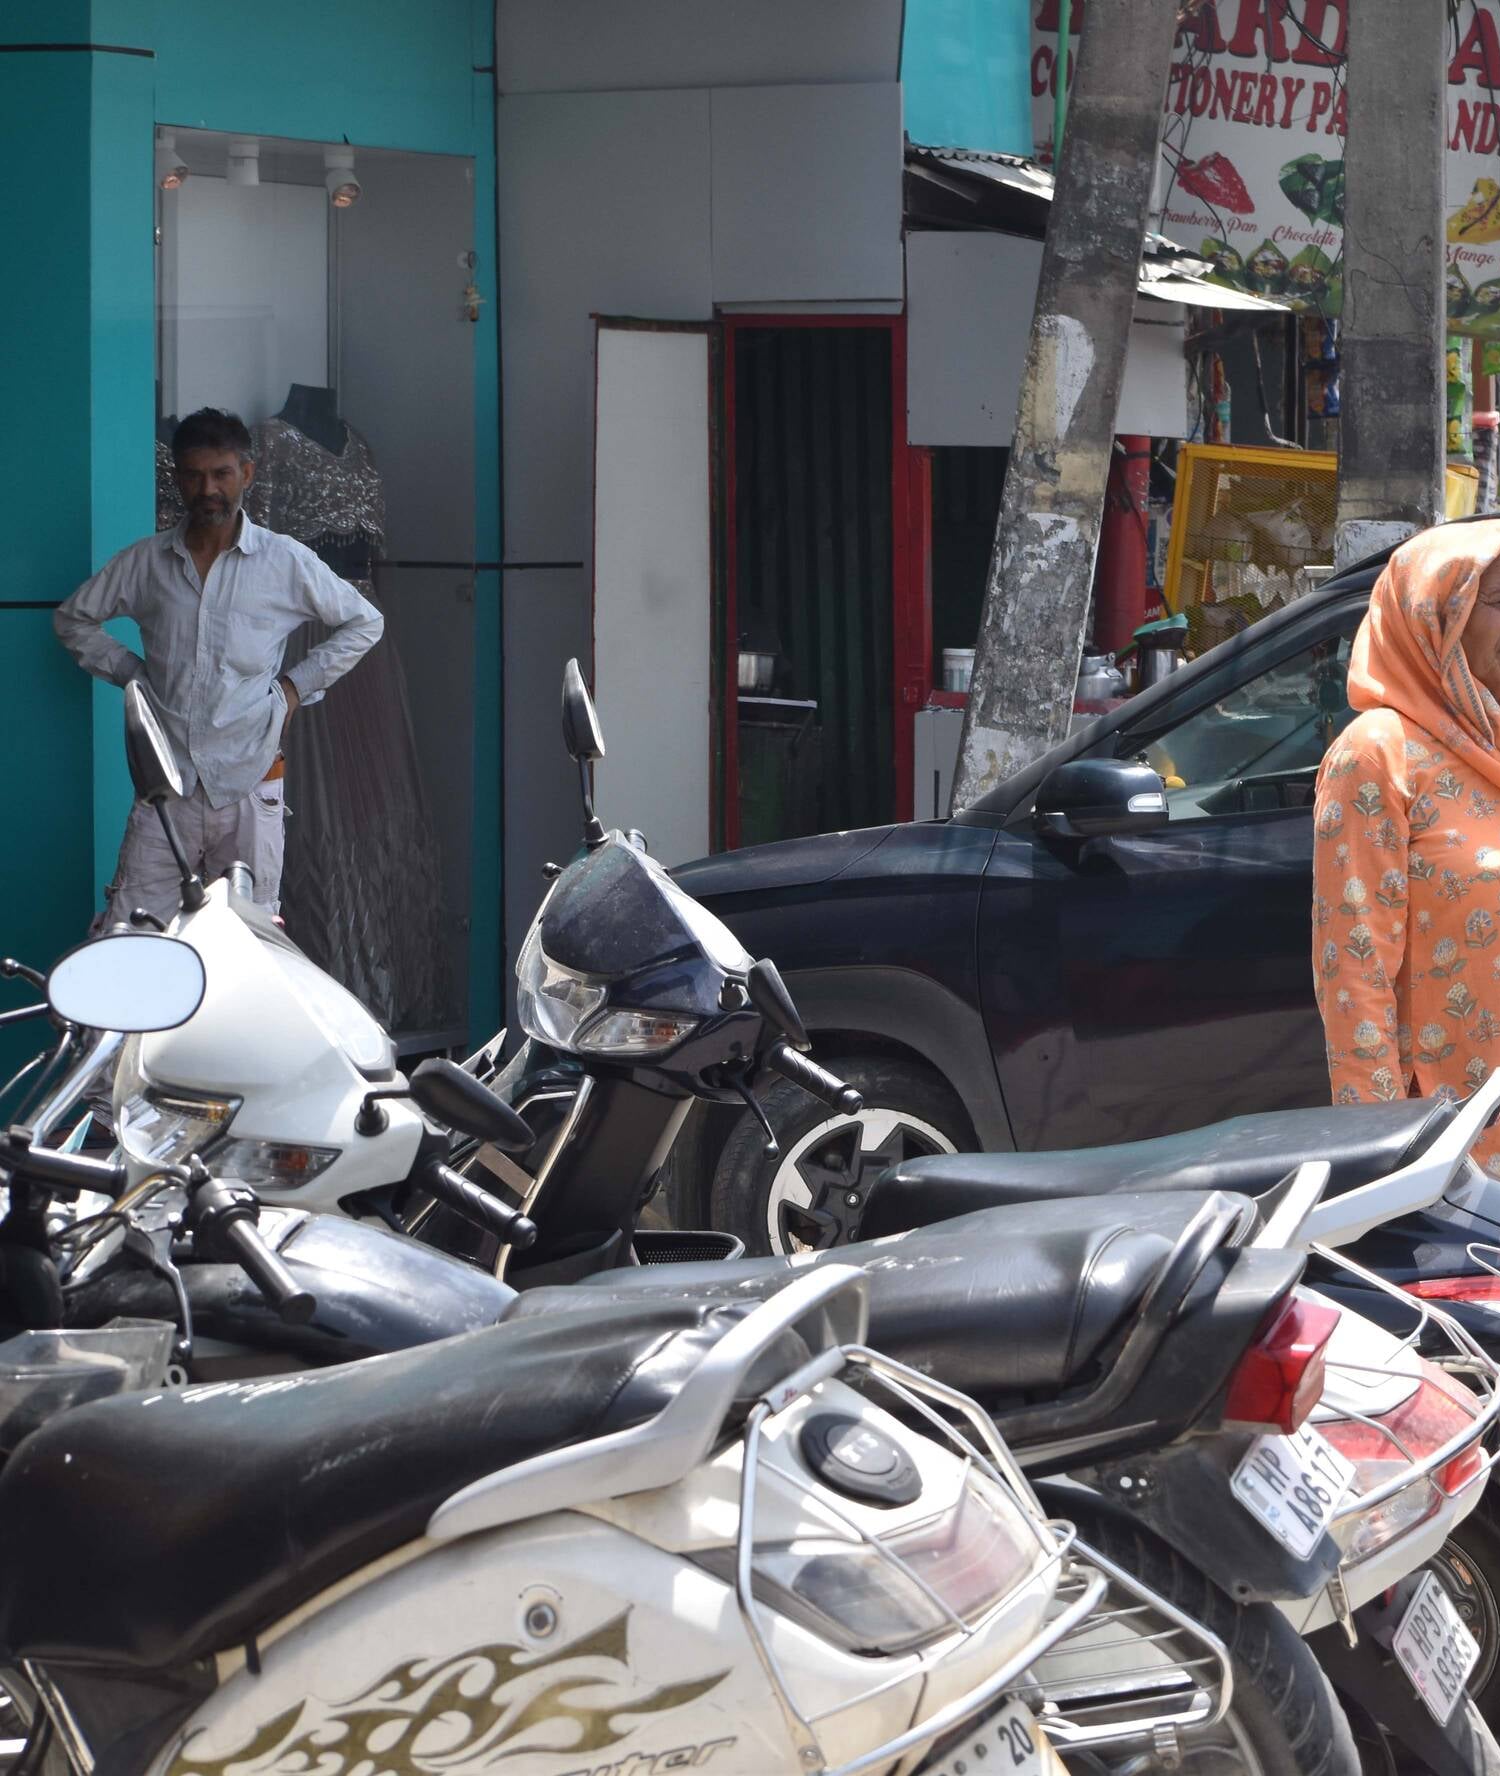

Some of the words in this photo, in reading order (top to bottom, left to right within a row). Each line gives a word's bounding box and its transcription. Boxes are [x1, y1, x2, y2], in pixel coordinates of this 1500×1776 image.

[1306, 81, 1347, 136] PA
[1161, 207, 1223, 233] trawberry
[1226, 216, 1258, 233] Pan
[1271, 225, 1337, 246] Chocolate
